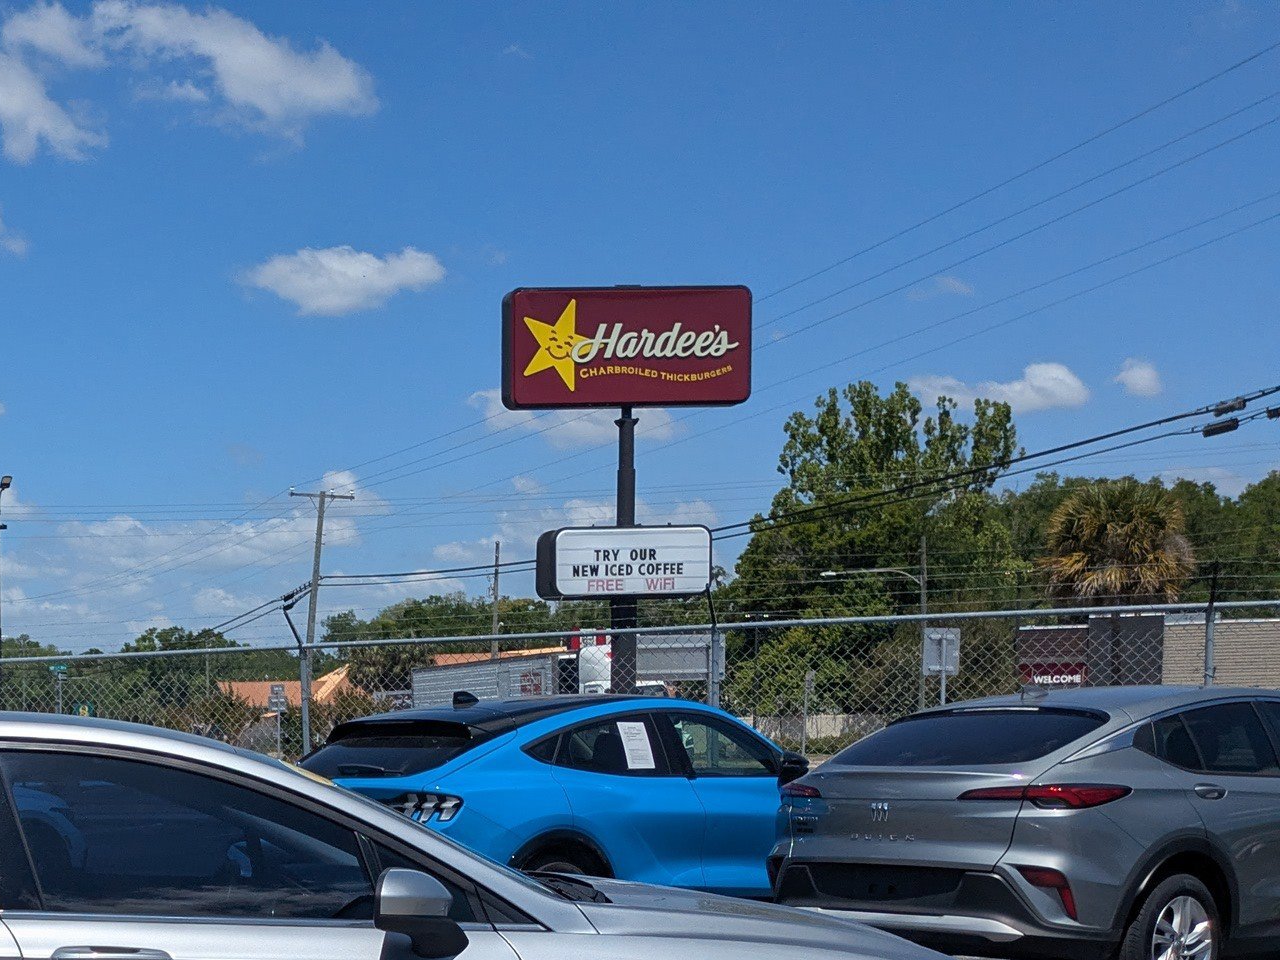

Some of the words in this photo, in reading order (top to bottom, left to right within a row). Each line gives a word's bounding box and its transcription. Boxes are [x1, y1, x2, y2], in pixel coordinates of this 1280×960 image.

[571, 322, 739, 363] Hardee's
[579, 365, 658, 379] CHARBROILED
[594, 549, 620, 561] TRY
[629, 548, 657, 561] OUR
[572, 564, 599, 577] NEW
[605, 563, 633, 577] ICED
[638, 562, 684, 576] COFFEE
[587, 579, 624, 592] FREE
[1033, 674, 1081, 684] WELCOME
